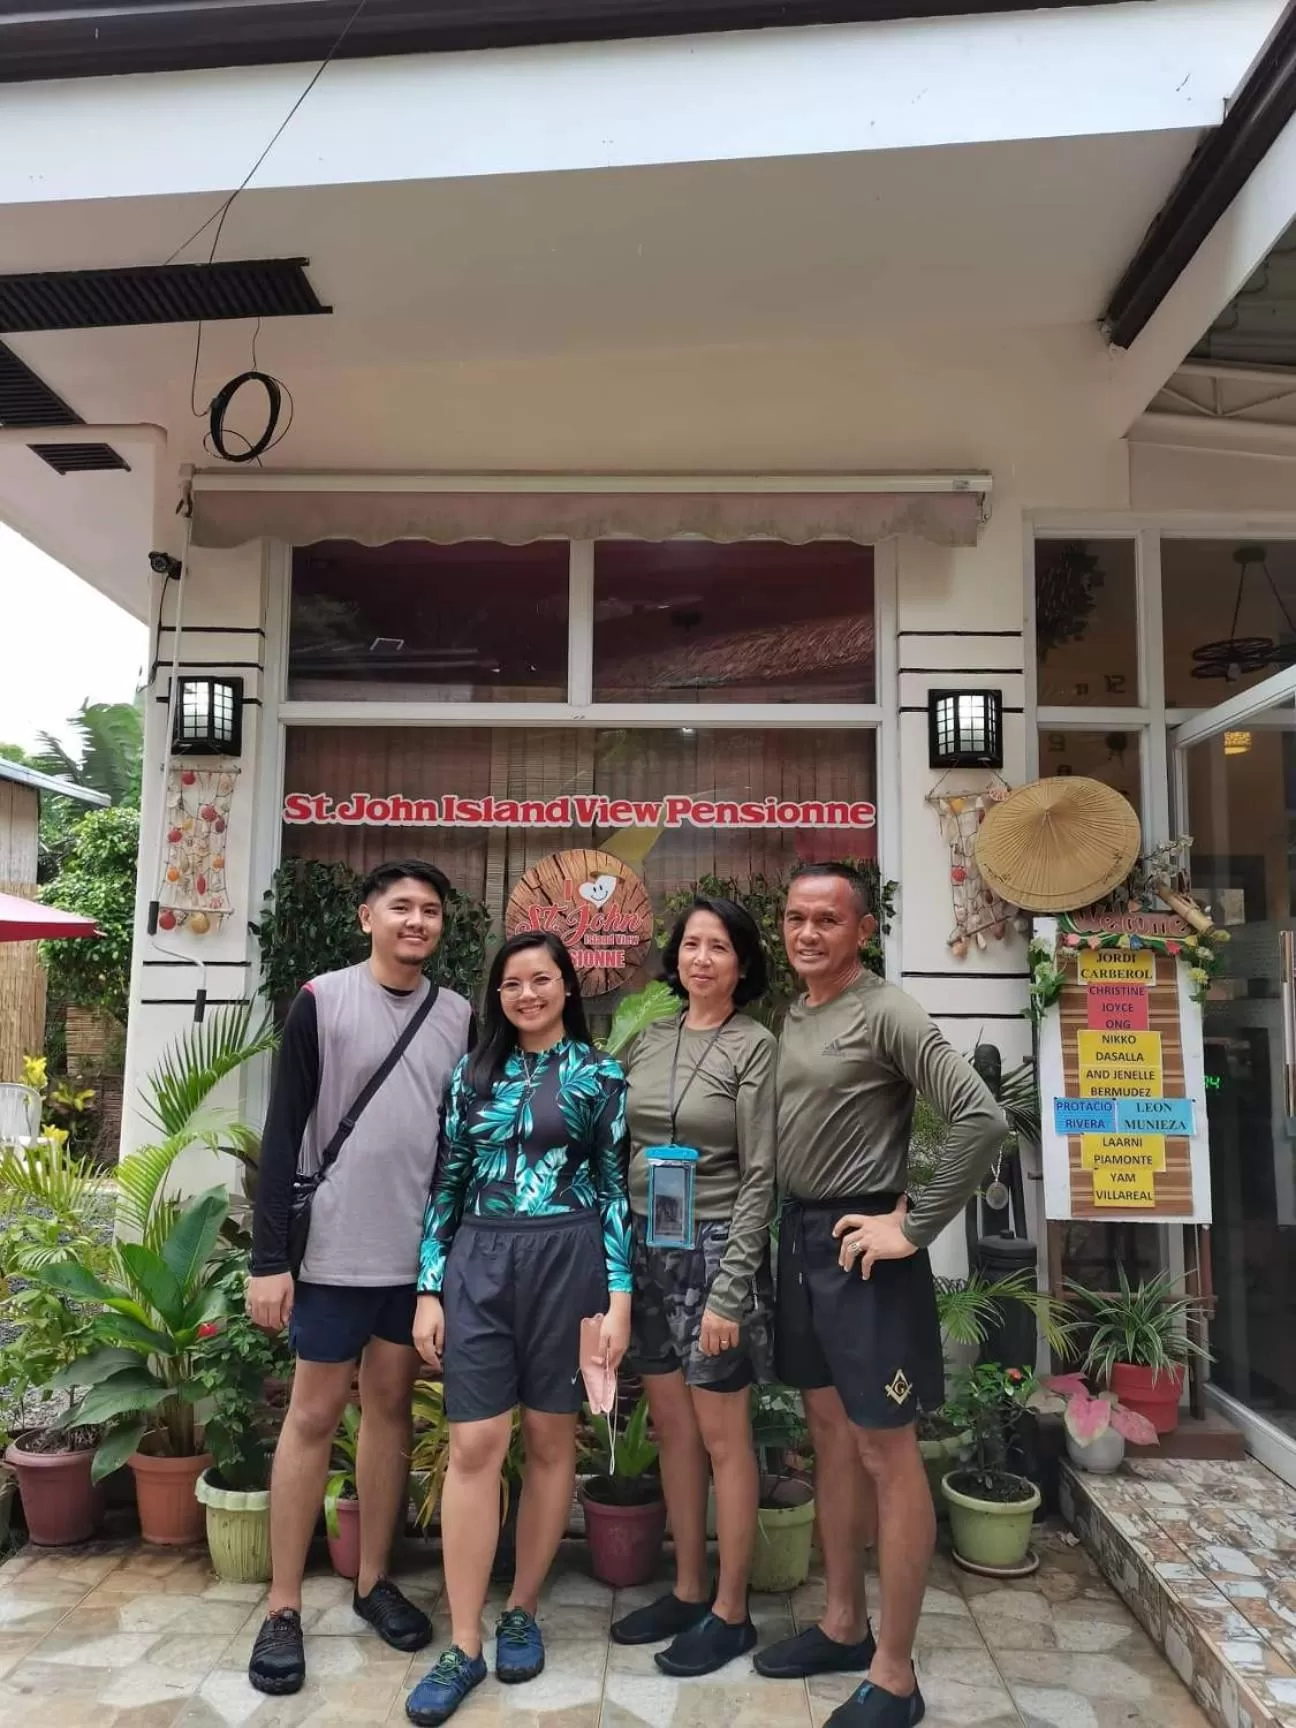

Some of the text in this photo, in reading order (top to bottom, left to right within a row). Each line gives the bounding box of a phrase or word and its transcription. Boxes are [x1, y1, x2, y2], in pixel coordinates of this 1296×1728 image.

[441, 795, 571, 827] Island
[573, 795, 663, 827] View
[664, 795, 876, 828] Pensionne
[560, 902, 643, 946] John
[1096, 952, 1136, 964] JORDI
[1080, 969, 1153, 979] CARBEROL
[1089, 986, 1145, 996] CHRISTINE
[1102, 1003, 1134, 1013] JOYCE
[1105, 1019, 1131, 1029] ONG
[1102, 1035, 1137, 1045] NIKKO
[1096, 1052, 1144, 1062] DASALLA
[1086, 1070, 1155, 1080] AND JENELLE
[1090, 1087, 1151, 1097] BERMUDEZ
[1056, 1101, 1113, 1111] PROTACIO
[1136, 1102, 1173, 1113] LEON
[1065, 1119, 1106, 1129] RIVERA
[1124, 1120, 1187, 1130] MUNIEZA
[1102, 1137, 1143, 1147] LAARNI
[1094, 1155, 1153, 1165] PIAMONTE
[1110, 1173, 1136, 1183] YAM
[1096, 1190, 1153, 1200] VILLAREAL
